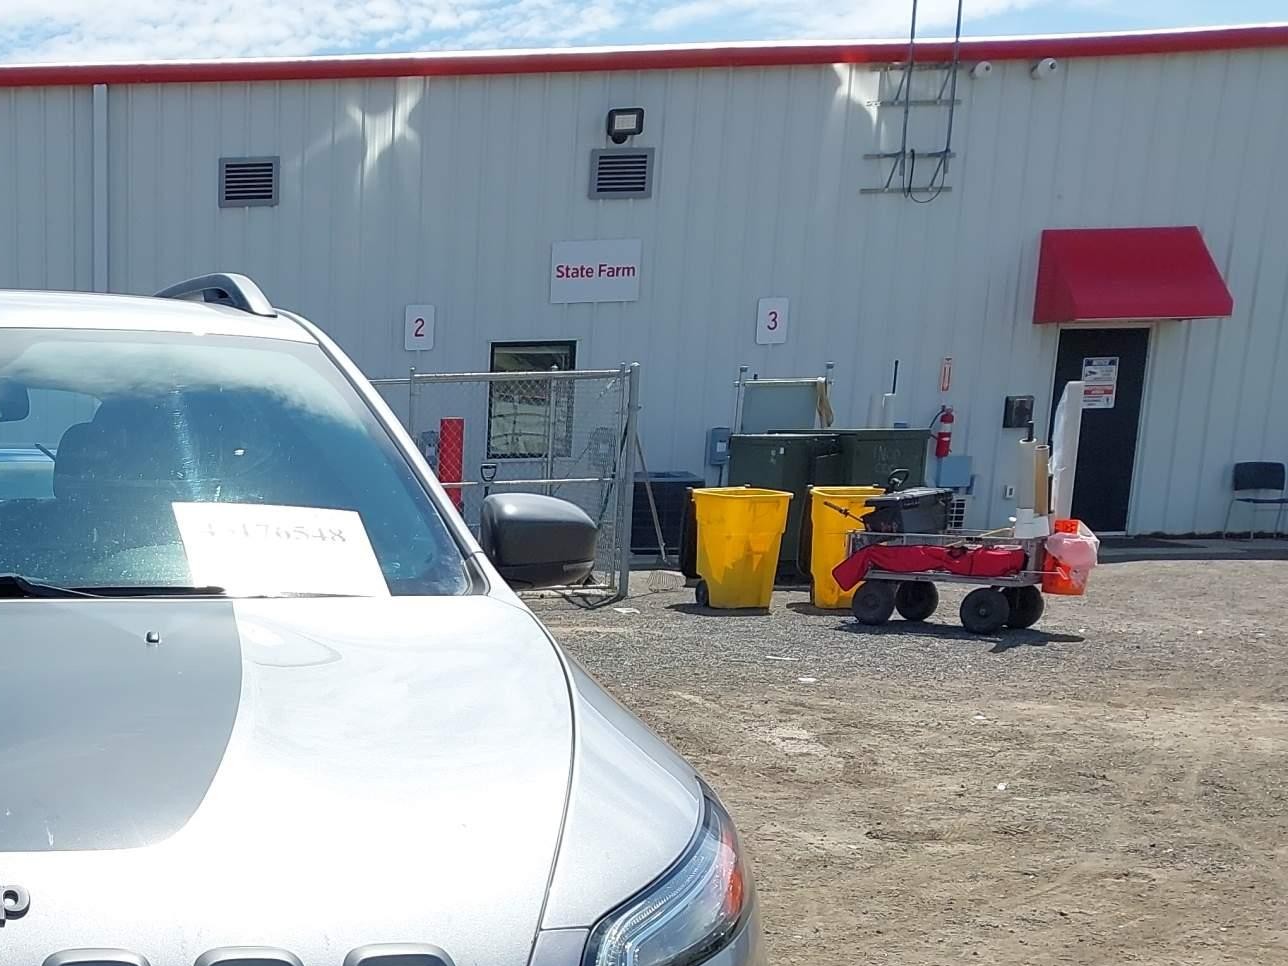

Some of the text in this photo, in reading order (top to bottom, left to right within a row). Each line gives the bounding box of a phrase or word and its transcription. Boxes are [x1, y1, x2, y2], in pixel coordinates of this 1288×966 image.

[556, 263, 636, 279] State Farm
[414, 318, 425, 337] 2
[767, 311, 778, 331] 3
[200, 522, 347, 543] 176548
